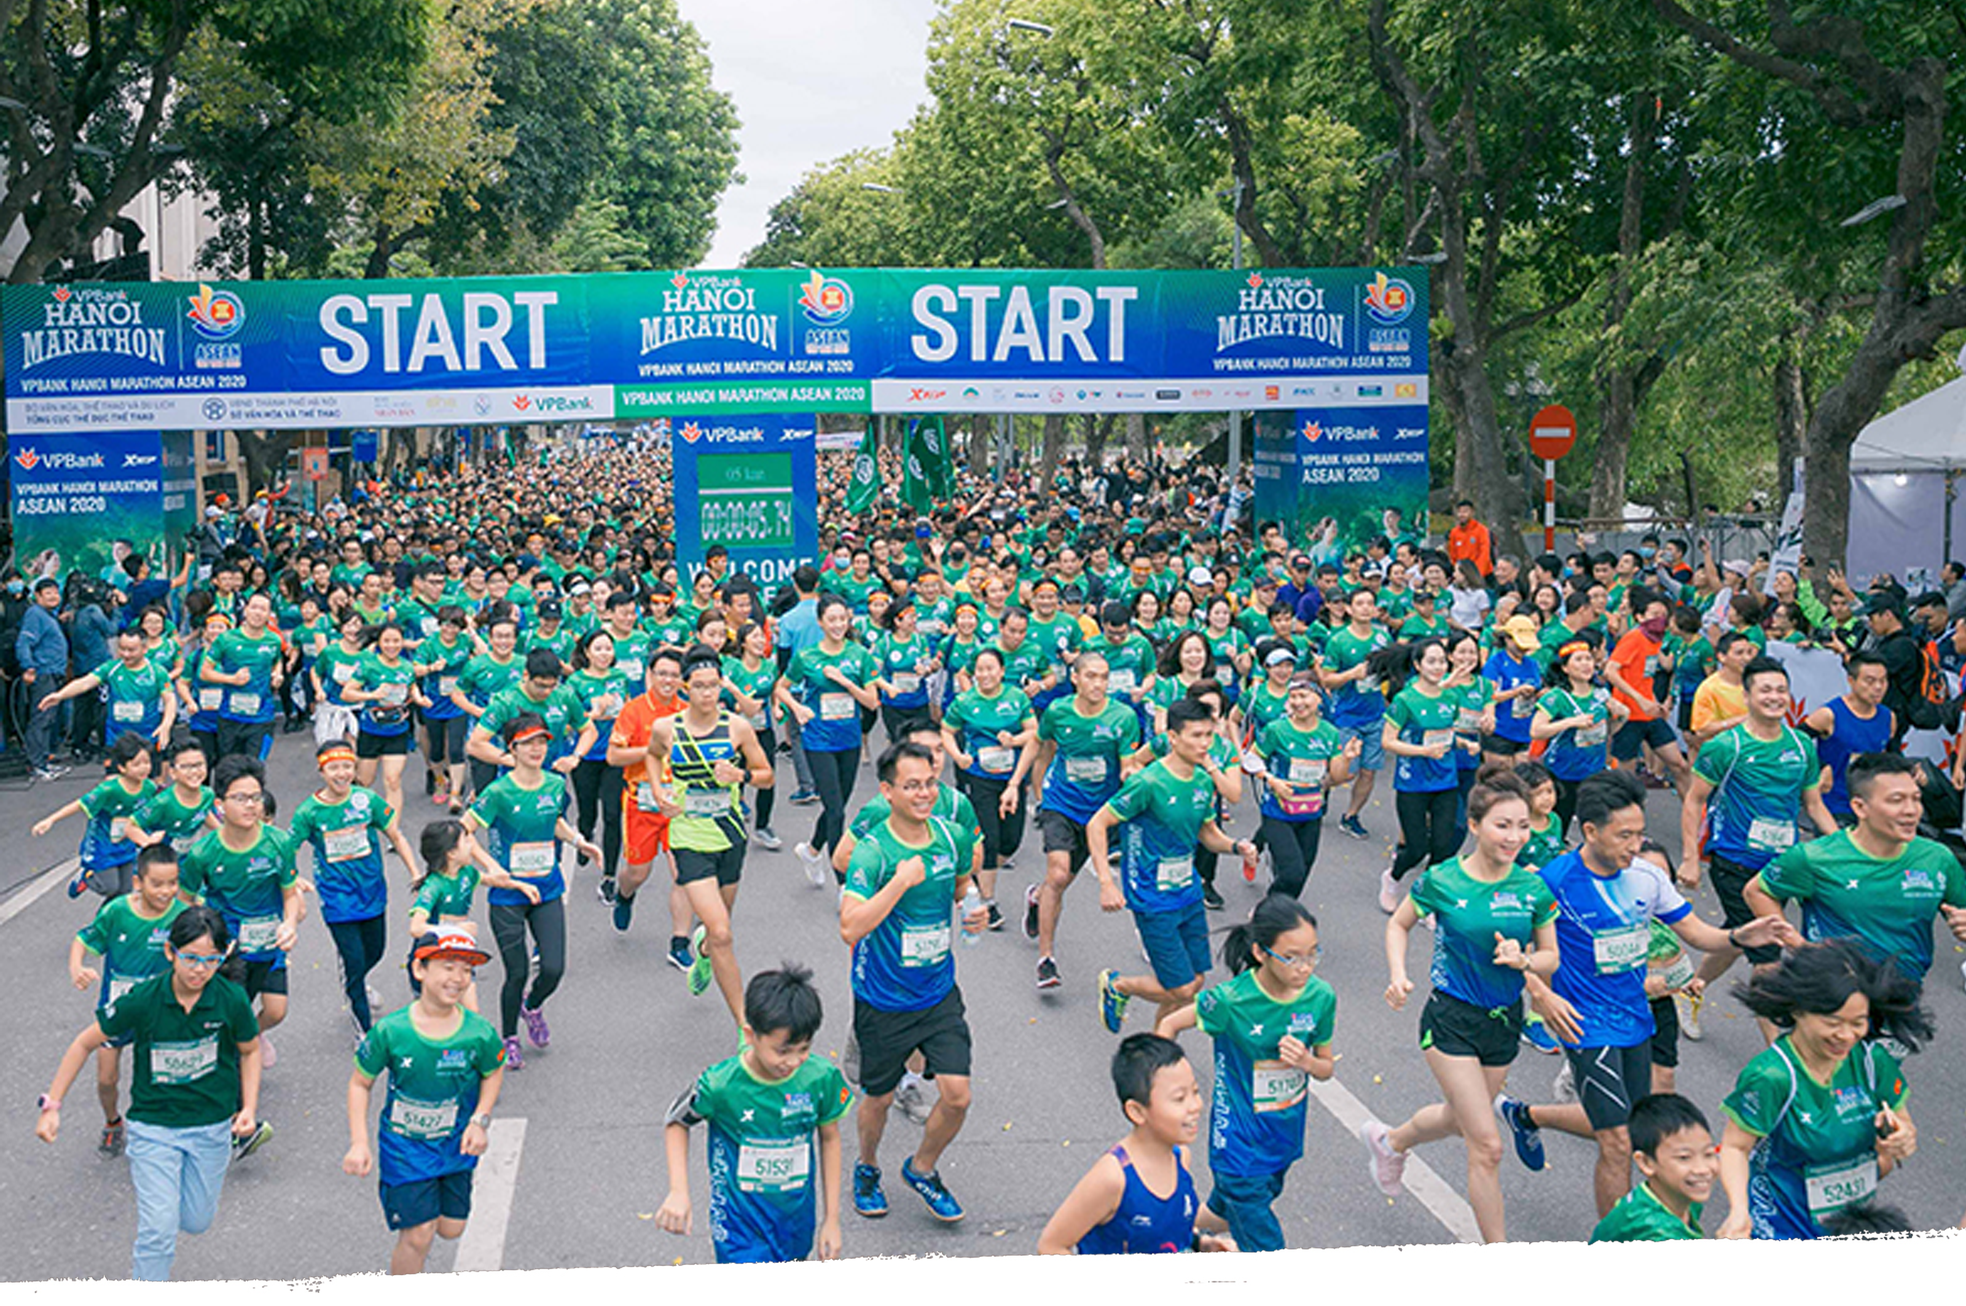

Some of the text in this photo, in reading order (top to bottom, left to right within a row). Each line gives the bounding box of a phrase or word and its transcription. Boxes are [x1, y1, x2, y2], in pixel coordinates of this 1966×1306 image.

[691, 275, 742, 289] VPBank
[1266, 276, 1313, 289] VPBank
[75, 288, 127, 301] VPBank
[662, 288, 756, 312] HANOI
[1238, 288, 1325, 311] HANOI
[44, 301, 142, 327] HANOI
[911, 284, 1138, 362] START
[319, 291, 558, 375] START
[640, 314, 778, 356] MARATHON
[1216, 315, 1344, 352] MARATHON
[21, 328, 165, 370] MARATHON
[639, 359, 854, 377] VPBANK HANOI MARATHON ASEAN 2020
[1213, 355, 1412, 371] VPBANK HANOI MARATHON ASEAN 2020
[20, 374, 247, 393] VPBANK HANOI MARATHON ASEAN 2020
[536, 396, 593, 412] VPBank
[622, 387, 866, 405] VPBANK HANOI MARATHON ASEAN 2020
[705, 426, 764, 443] VPBank
[1324, 426, 1380, 441] VPBank
[42, 453, 104, 468] VPBank
[1302, 454, 1340, 466] VPBANK
[1373, 451, 1425, 464] MARATHON
[1302, 466, 1380, 483] ASEAN 2020
[16, 479, 158, 496] VPBANK HANOI MARATHON
[17, 495, 106, 514] ASEAN 2020
[403, 1111, 443, 1128] 51427
